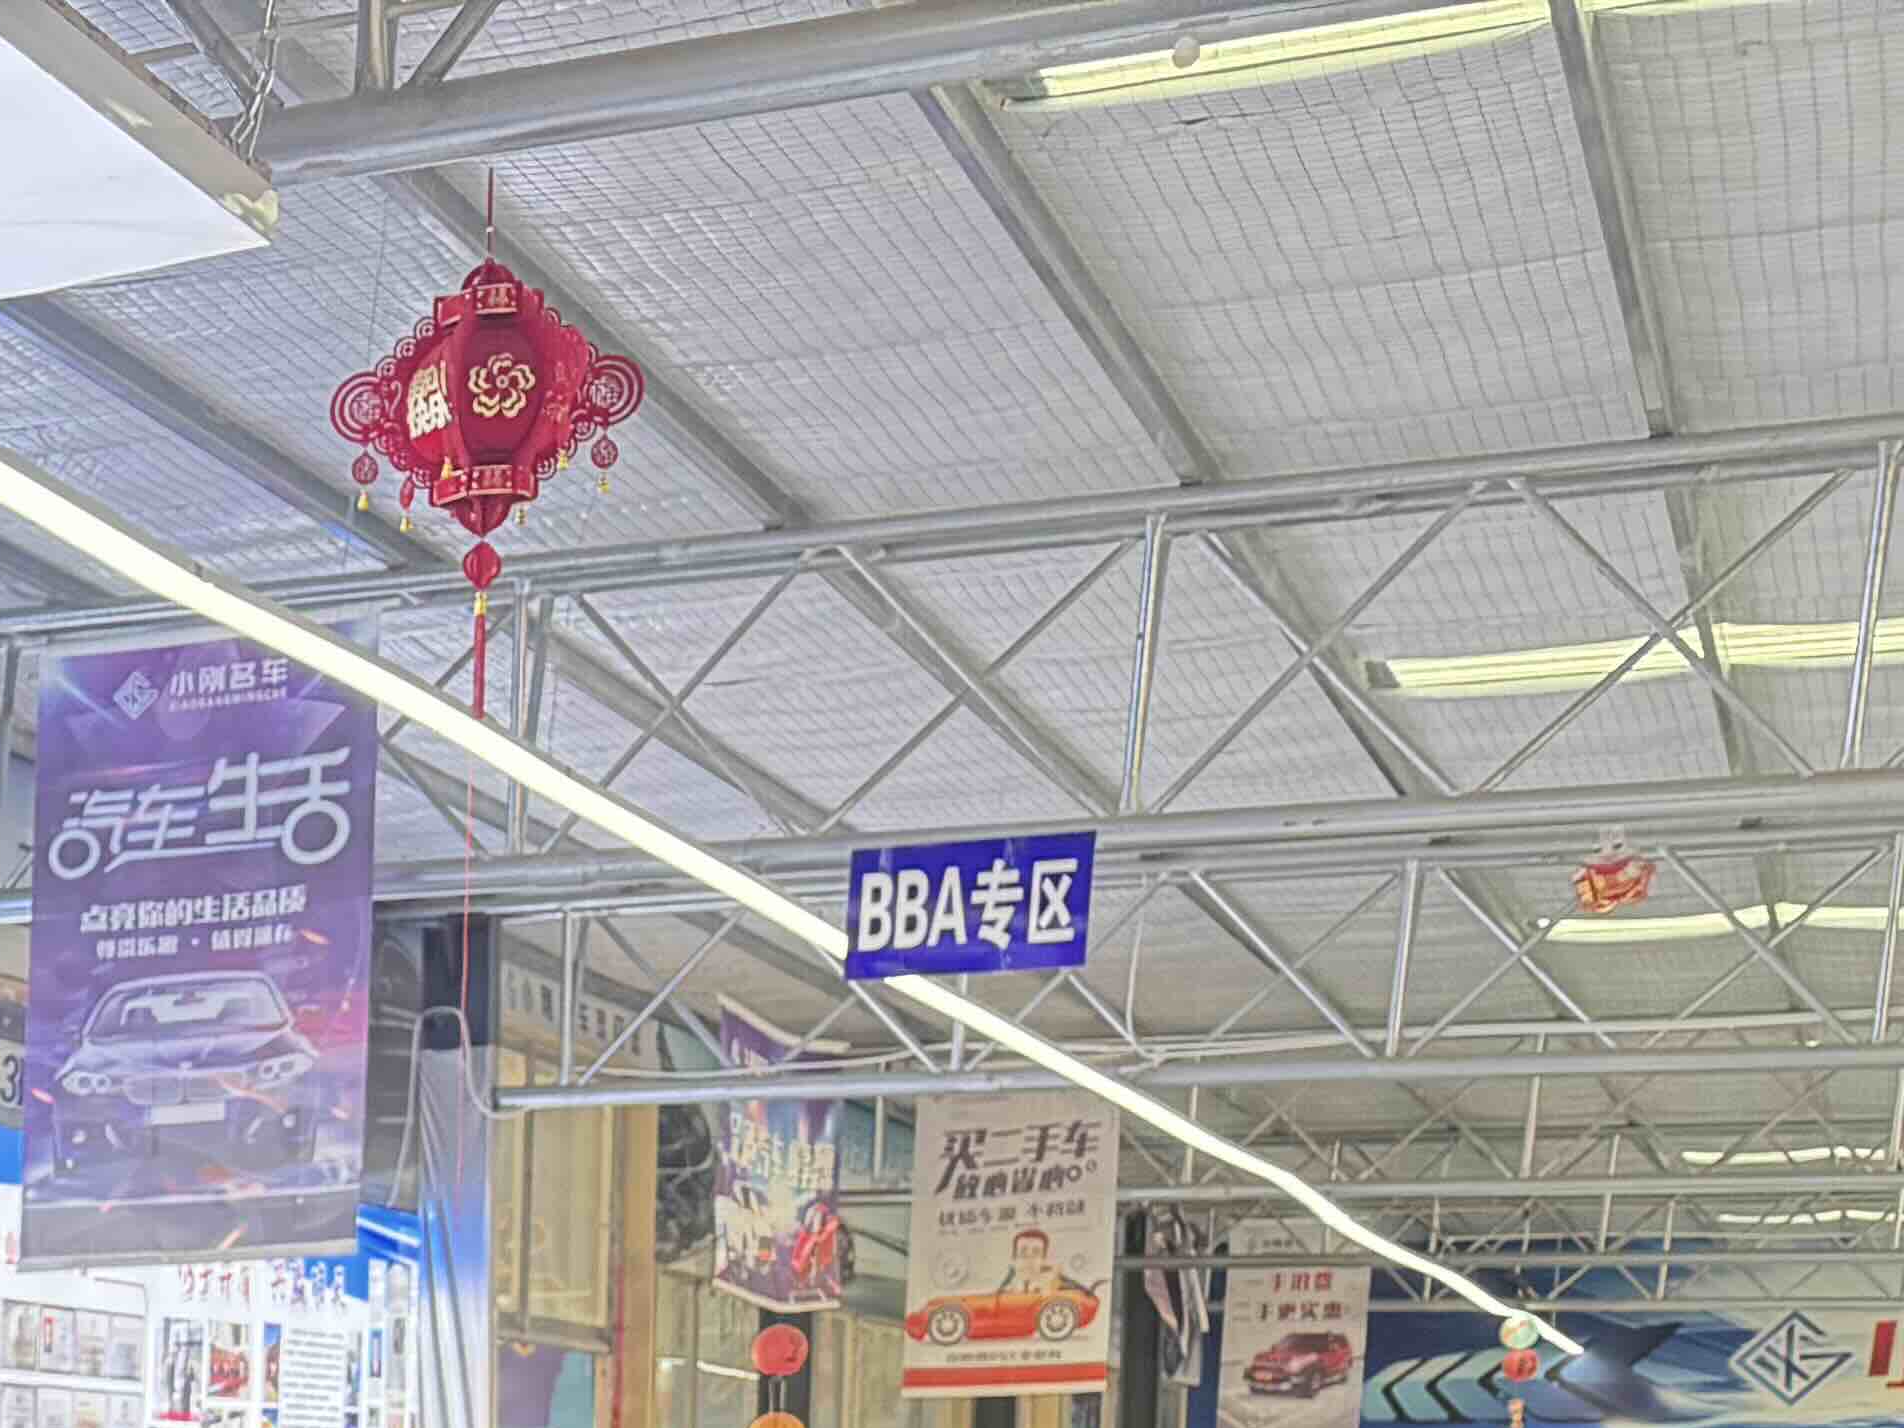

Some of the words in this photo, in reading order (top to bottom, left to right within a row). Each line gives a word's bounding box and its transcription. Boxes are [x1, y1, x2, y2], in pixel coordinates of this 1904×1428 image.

[168, 657, 290, 698] 小刚名车
[47, 746, 352, 881] 汽车生活
[856, 857, 1080, 953] BBA专区
[934, 1118, 1104, 1197] 买二手车
